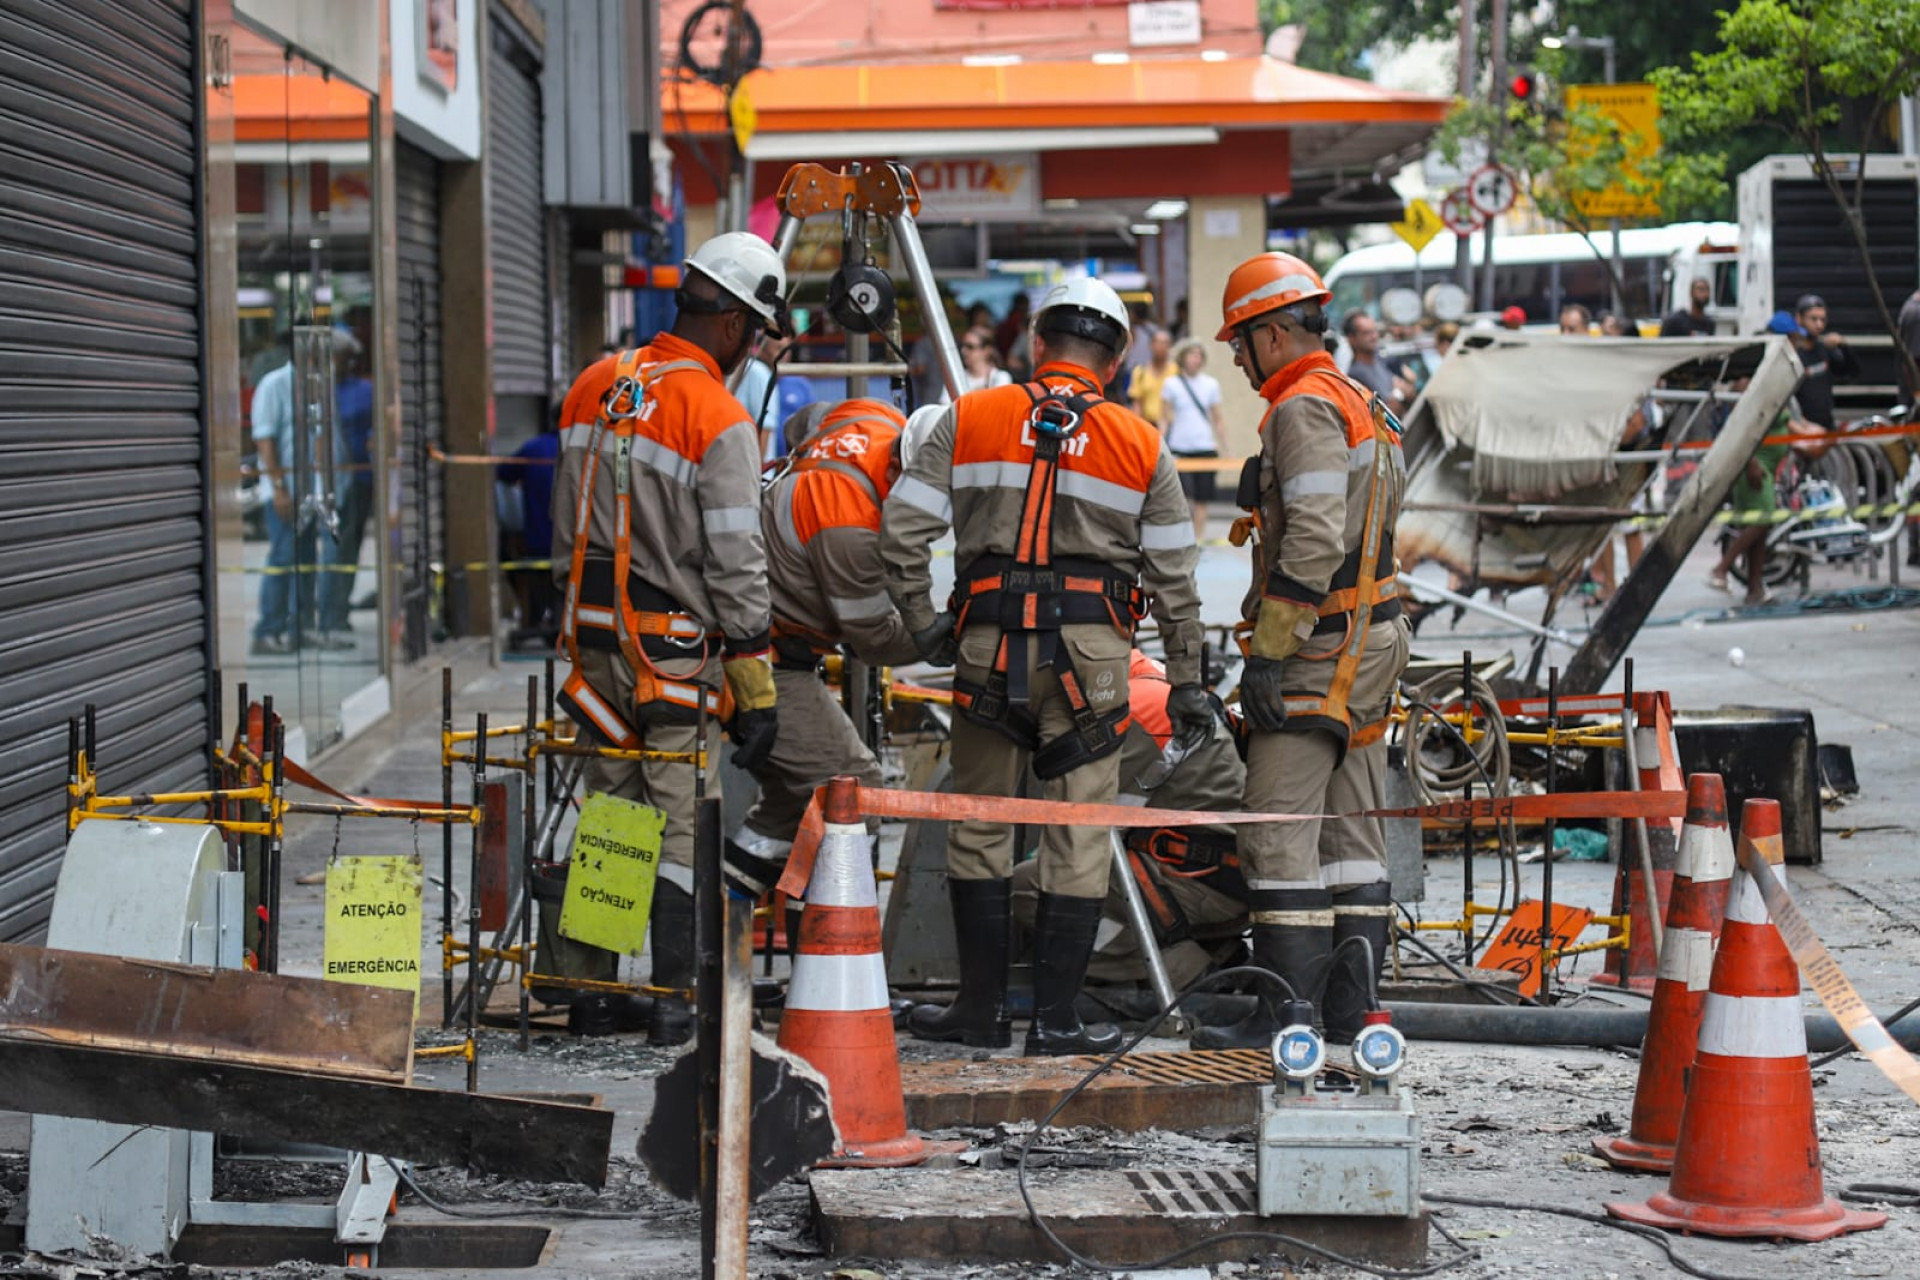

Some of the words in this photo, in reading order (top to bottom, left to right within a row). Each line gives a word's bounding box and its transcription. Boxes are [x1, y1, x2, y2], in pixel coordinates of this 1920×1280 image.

[1403, 799, 1513, 817] PERIGO
[580, 832, 654, 863] EMERGÊNCIA
[580, 885, 636, 911] ATENÇÃO
[340, 900, 408, 919] ATENÇÃO
[327, 956, 418, 975] EMERGÊNCIA
